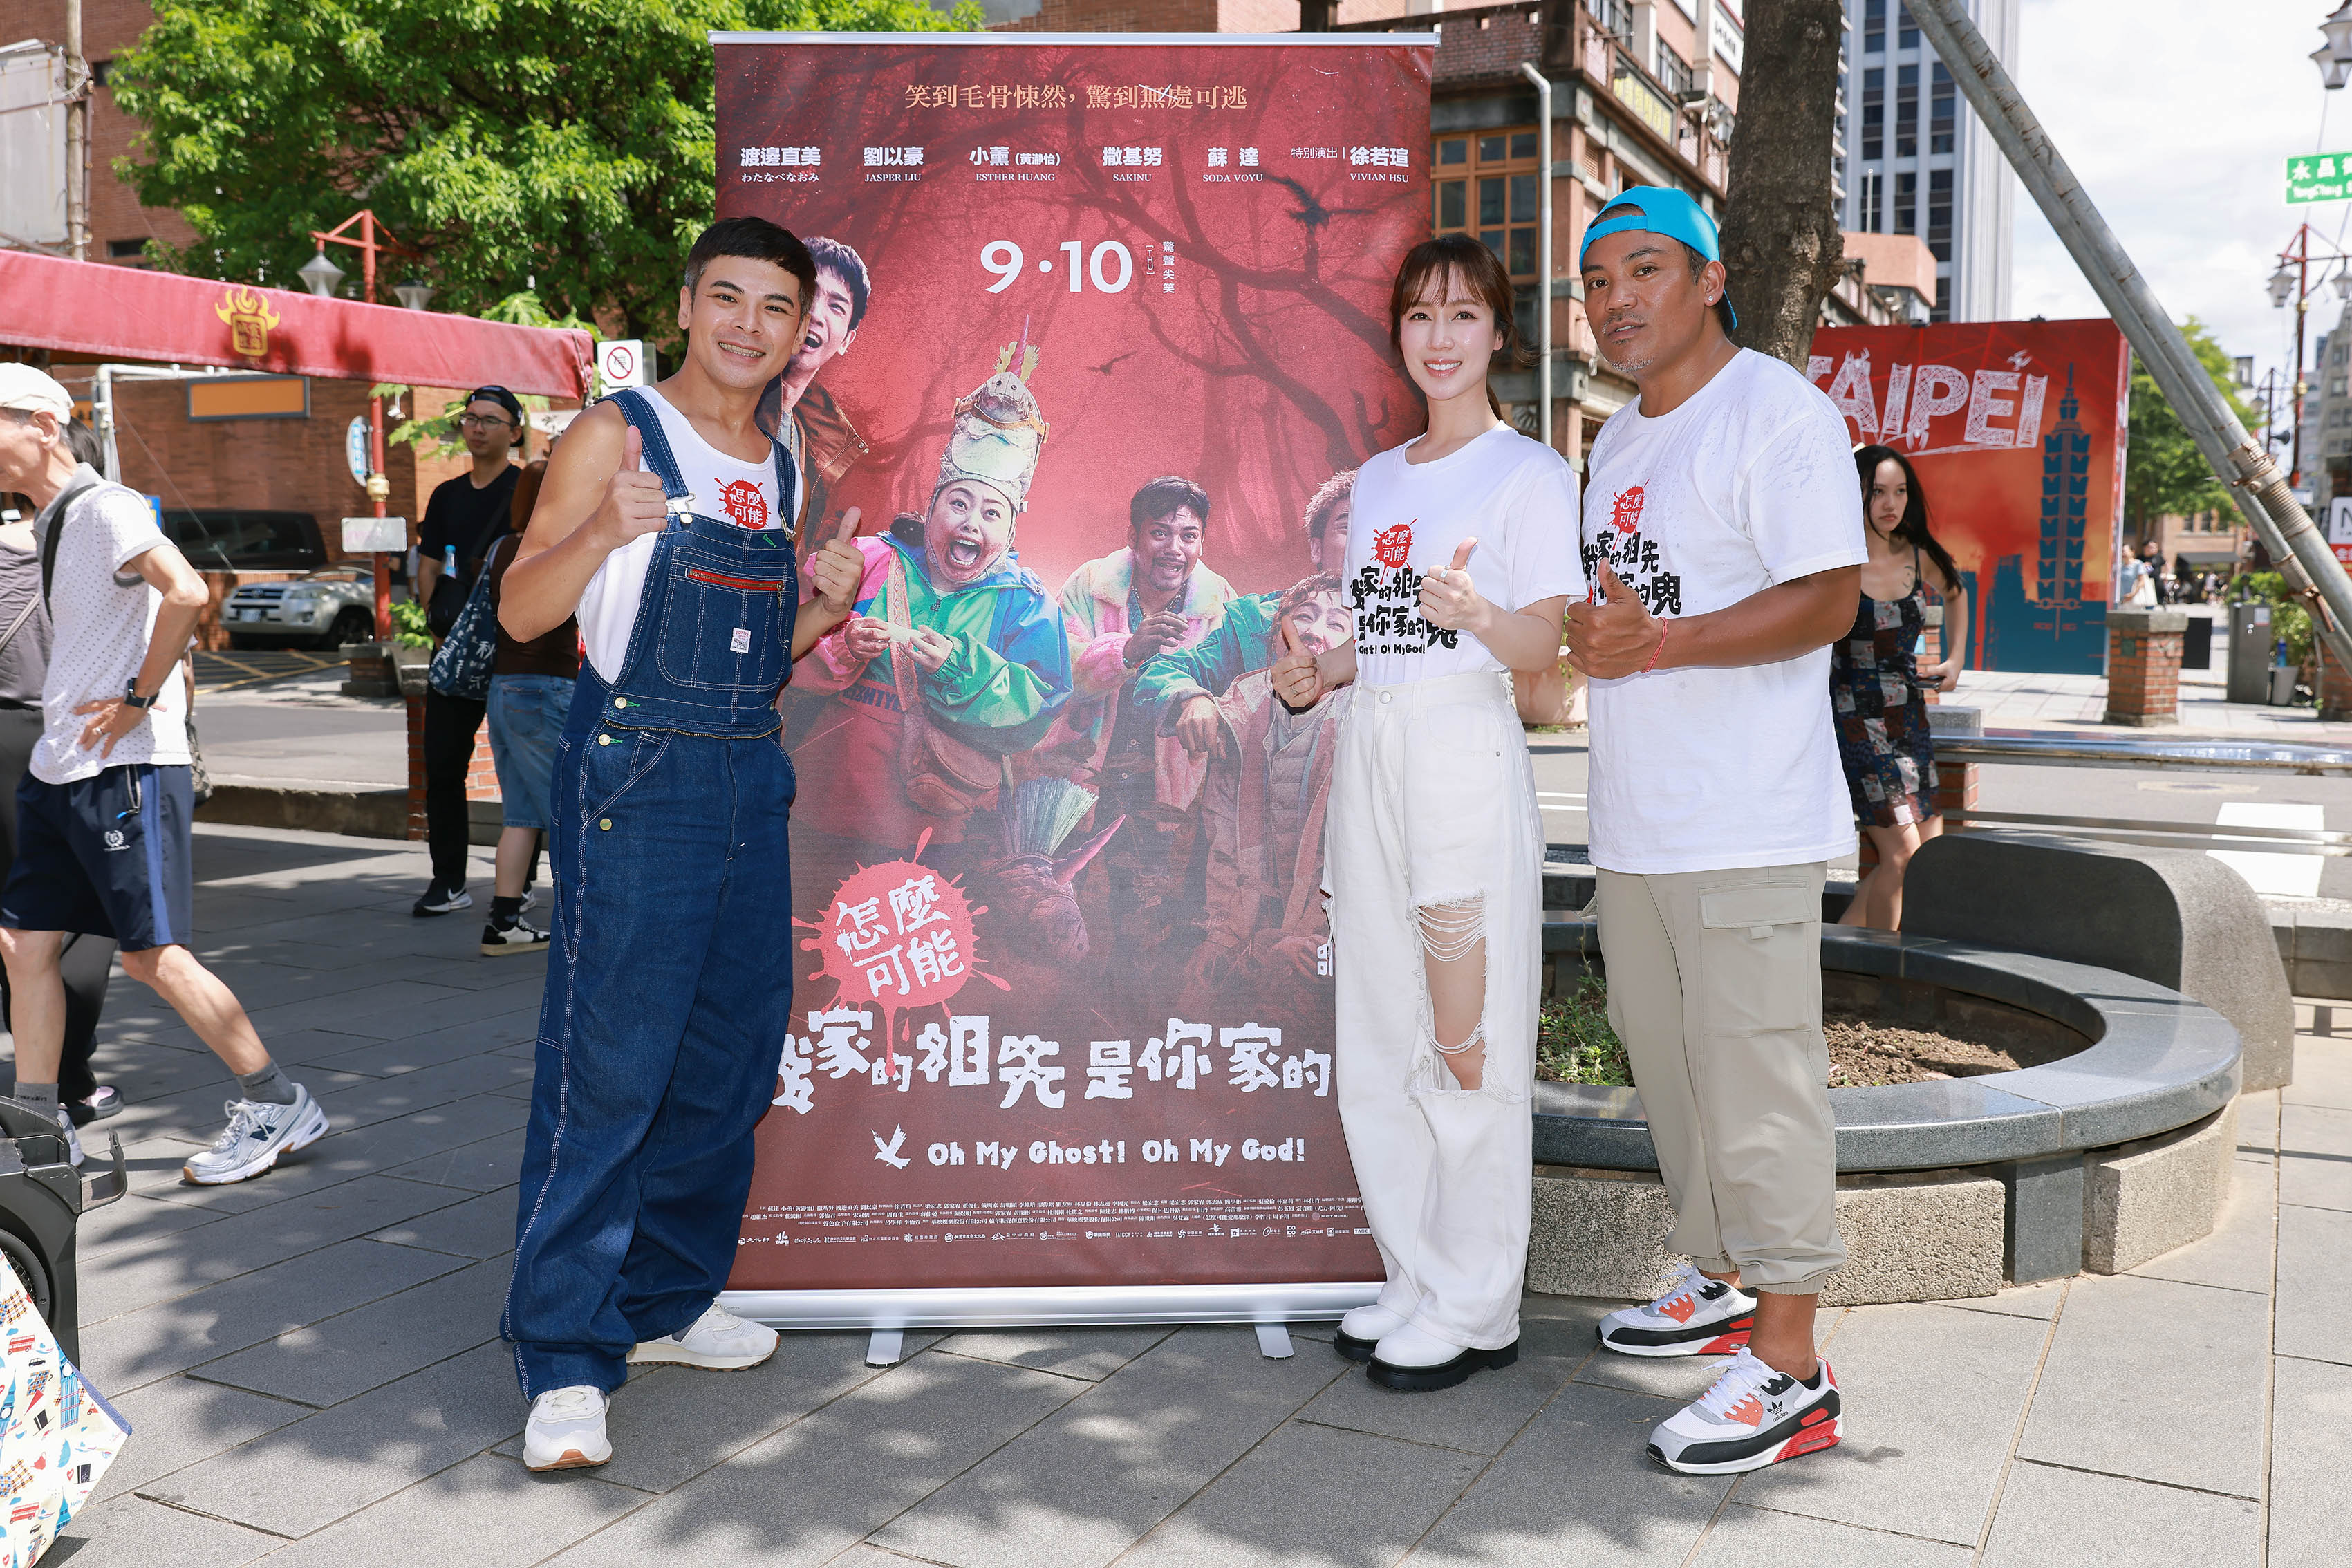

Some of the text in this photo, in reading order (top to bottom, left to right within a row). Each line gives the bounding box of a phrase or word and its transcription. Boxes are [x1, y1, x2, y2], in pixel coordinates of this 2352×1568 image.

[740, 147, 821, 167] 渡邊直美
[864, 147, 924, 167] 劉以豪
[1103, 147, 1163, 167] 撒基努
[1291, 147, 1409, 167] 特別演出 徐若瑄
[741, 172, 819, 183] わたなべなおみ
[865, 173, 922, 183] JASPER LIU
[976, 173, 1055, 183] ESTHER HUANG
[1112, 174, 1152, 183] SAKINU
[1202, 174, 1263, 183] SODA VOYU
[1350, 173, 1410, 183] VIVIAN HSU
[1162, 241, 1175, 294] 驚聲尖笑
[729, 485, 763, 508] 怎麼
[1620, 492, 1644, 510] 怎麼
[733, 505, 764, 525] 可能
[1619, 510, 1638, 527] 可能
[1383, 529, 1410, 545] 怎麼
[1383, 547, 1406, 561] 可能
[835, 874, 951, 951] 怎麼
[852, 931, 965, 998] 可能
[927, 1137, 1305, 1170] Oh My Ghost! Oh My God!
[1773, 1411, 1789, 1423] adidas
